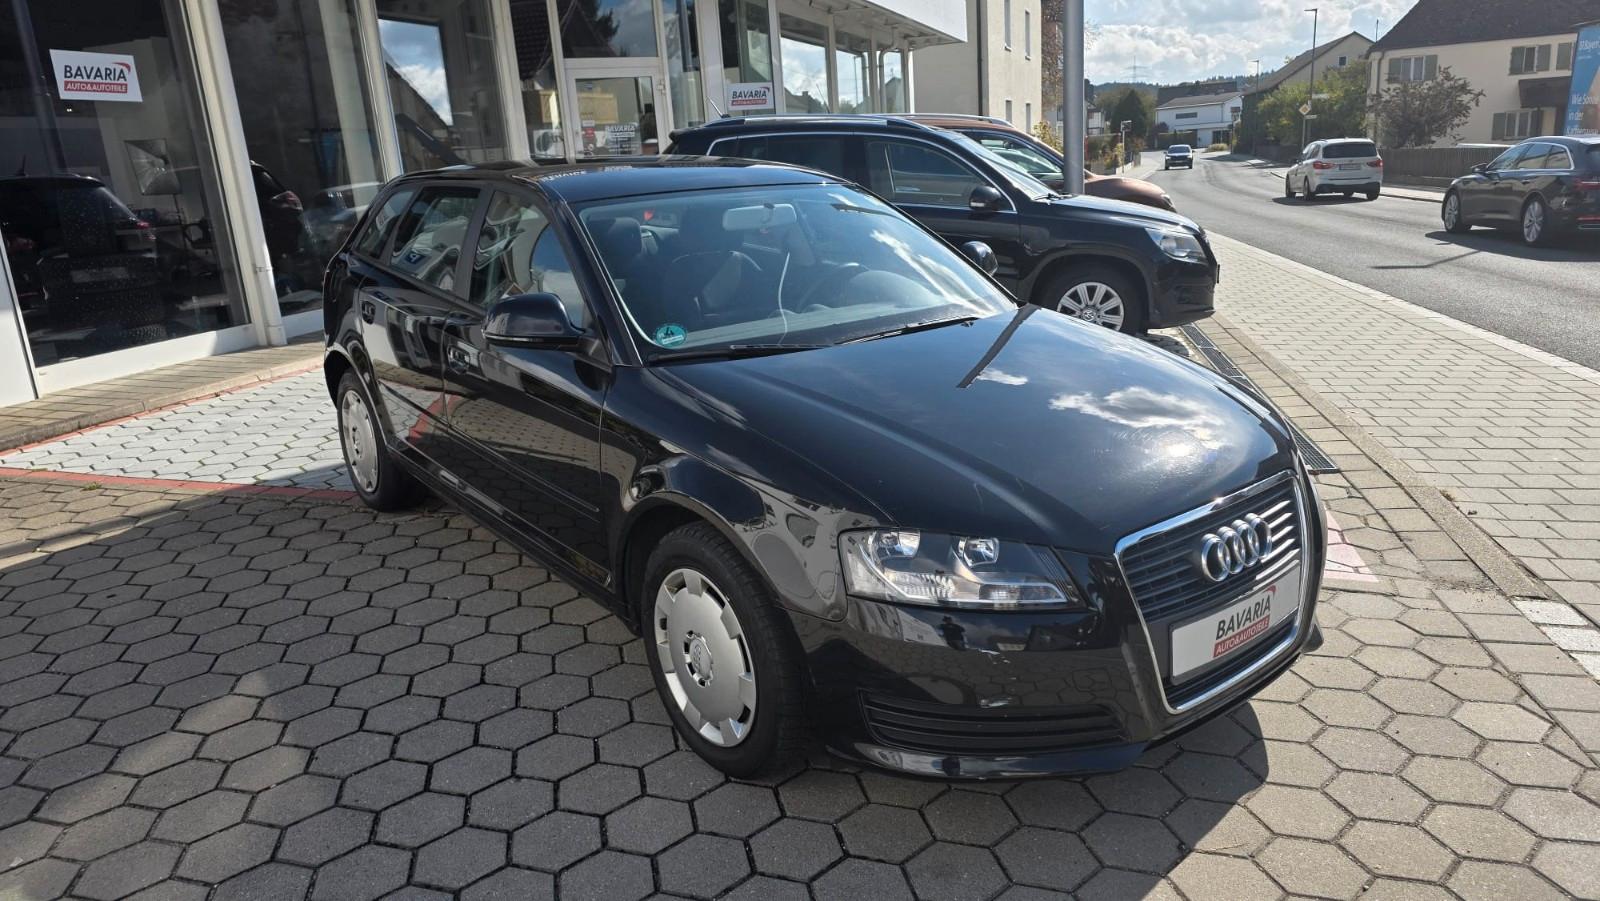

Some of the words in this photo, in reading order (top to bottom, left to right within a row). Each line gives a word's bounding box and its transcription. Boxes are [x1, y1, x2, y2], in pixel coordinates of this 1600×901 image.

[64, 65, 127, 81] BAVARIA
[66, 82, 127, 92] AUTO&AUTOTEILE
[731, 89, 767, 101] BAVARIA
[605, 124, 636, 134] BAVARIA
[1215, 595, 1272, 641] BAVARIA
[1215, 617, 1270, 654] AUTO&AUTOTEILE
